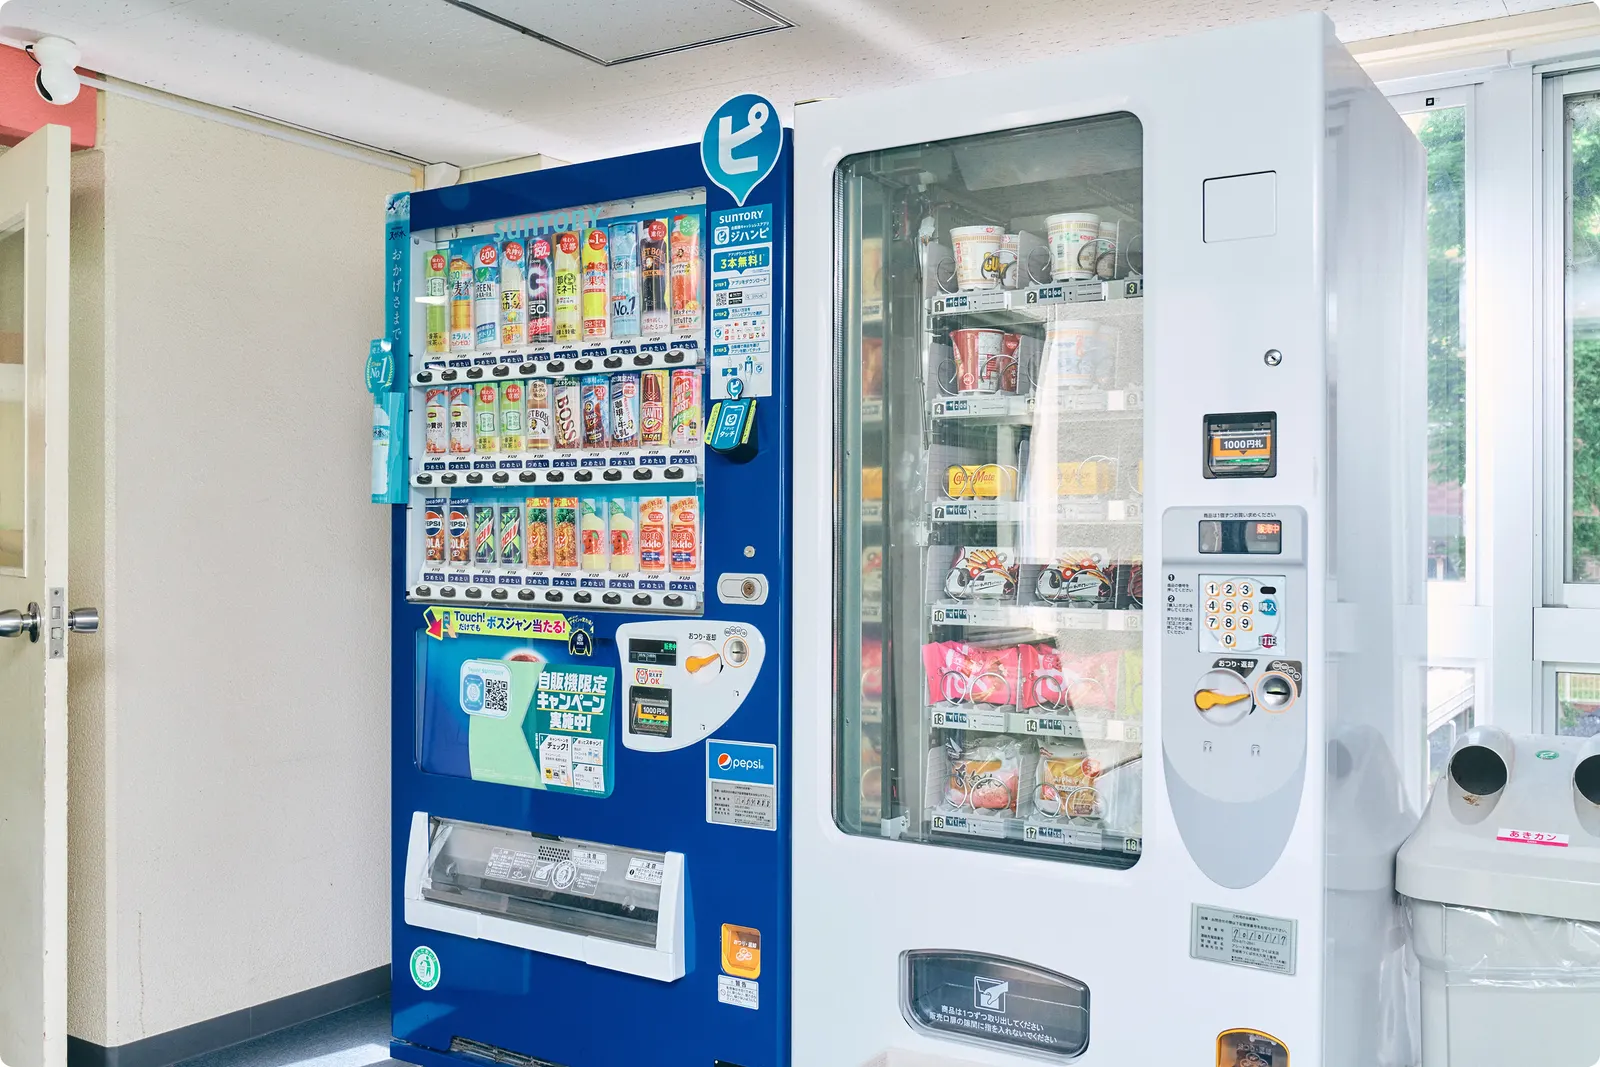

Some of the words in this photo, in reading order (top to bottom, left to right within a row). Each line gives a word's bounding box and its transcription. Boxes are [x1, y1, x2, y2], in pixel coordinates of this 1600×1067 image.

[717, 101, 770, 175] ピ
[719, 210, 763, 224] SUNTORY
[731, 227, 770, 242] ジハンピ
[480, 250, 495, 260] 600
[1129, 284, 1135, 294] 3
[392, 248, 402, 341] おかげさまで
[1028, 292, 1034, 303] 2
[614, 296, 636, 316] No.1
[936, 300, 942, 312] 1
[730, 380, 740, 393] ピ
[936, 404, 941, 414] 4
[556, 394, 577, 444] BOSS
[1224, 440, 1264, 449] 1000円札
[937, 509, 942, 518] 7
[1256, 524, 1280, 534] 販売中
[1210, 585, 1214, 593] 1
[1226, 585, 1232, 593] 2
[1242, 585, 1248, 594] 3
[1209, 601, 1215, 610] 4
[1226, 602, 1231, 611] 5
[1242, 602, 1248, 611] 6
[1259, 602, 1277, 612] 購入
[454, 610, 486, 623] Touch!
[935, 611, 944, 622] 10
[458, 623, 480, 632] だけでも
[486, 616, 566, 634] ボスジャン当たる!
[1209, 618, 1215, 627] 7
[1226, 618, 1232, 627] 8
[1242, 619, 1249, 628] 9
[688, 632, 717, 641] おつり・返却
[1225, 635, 1231, 644] 0
[1258, 636, 1277, 646] 訂正
[538, 672, 608, 694] 自販機限定
[537, 692, 606, 714] キャンペーン
[643, 706, 668, 716] 1000円札
[550, 712, 592, 731] 実施中!
[934, 714, 944, 724] 13
[1027, 720, 1036, 731] 14
[547, 742, 569, 751] チェック!
[732, 758, 762, 770] pepsi
[934, 818, 943, 828] 16
[1027, 828, 1036, 838] 17
[1510, 830, 1556, 841] あきカン
[1126, 839, 1136, 850] 18
[941, 1004, 1044, 1032] 商品は1つずつ取り出してください
